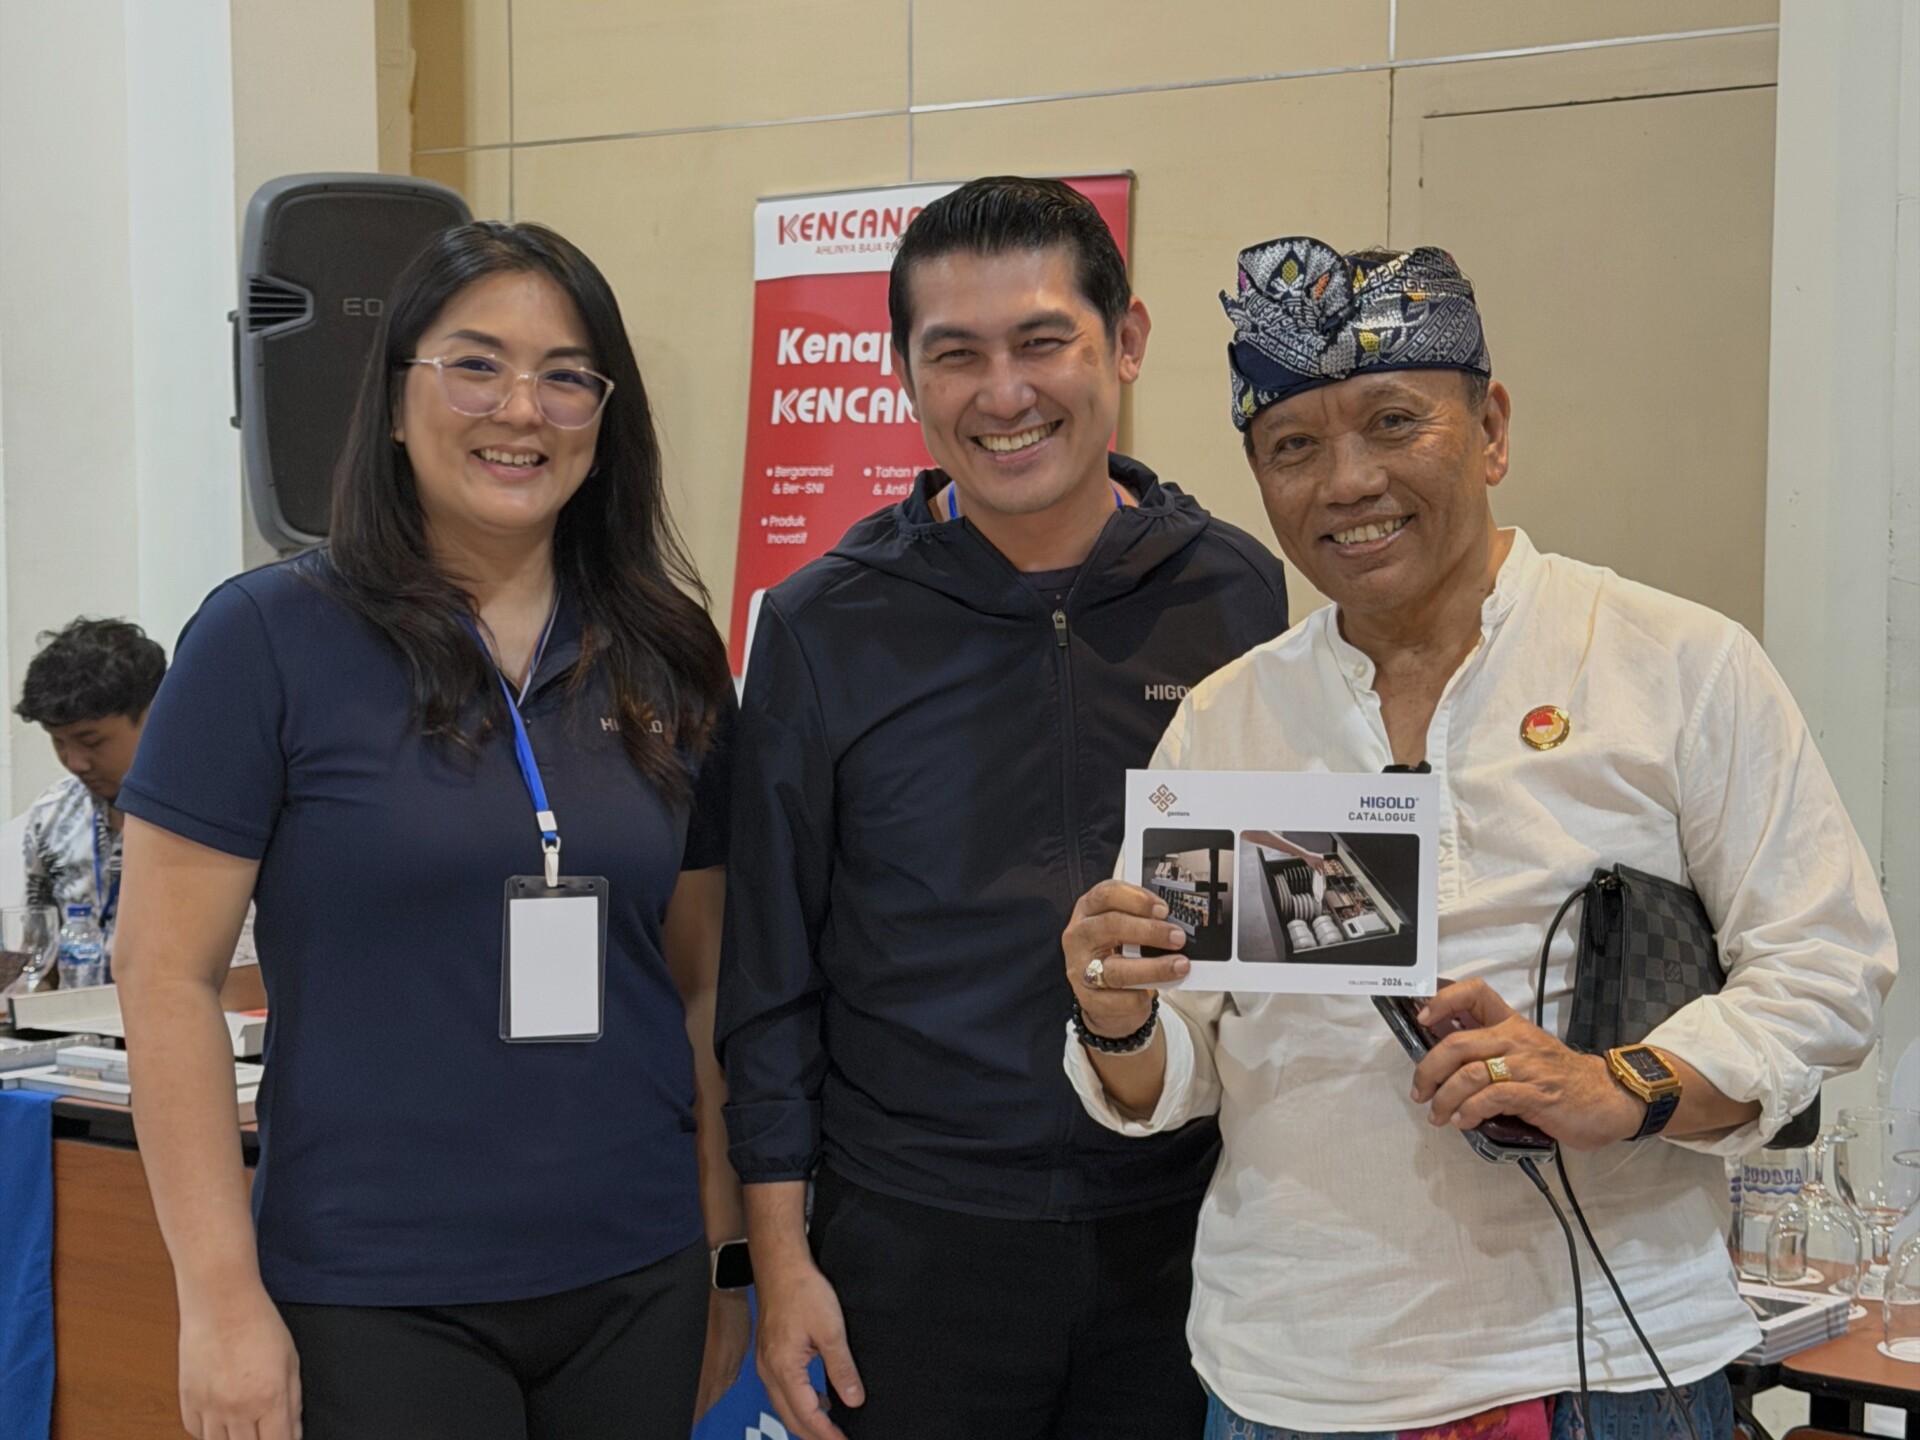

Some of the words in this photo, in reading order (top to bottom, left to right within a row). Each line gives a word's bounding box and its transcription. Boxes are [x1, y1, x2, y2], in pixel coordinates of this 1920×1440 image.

[858, 242, 883, 253] BAJA
[774, 465, 834, 480] Bergaransi
[875, 466, 911, 478] Tahan
[772, 483, 781, 495] &
[782, 483, 825, 494] Ber-SNI
[872, 484, 883, 496] &
[884, 483, 907, 495] Anti
[769, 515, 806, 527] Produk
[767, 532, 808, 544] Inovatif
[1144, 684, 1191, 700] HIGO
[1348, 812, 1416, 822] CATALOGUE
[1382, 977, 1402, 986] 2026
